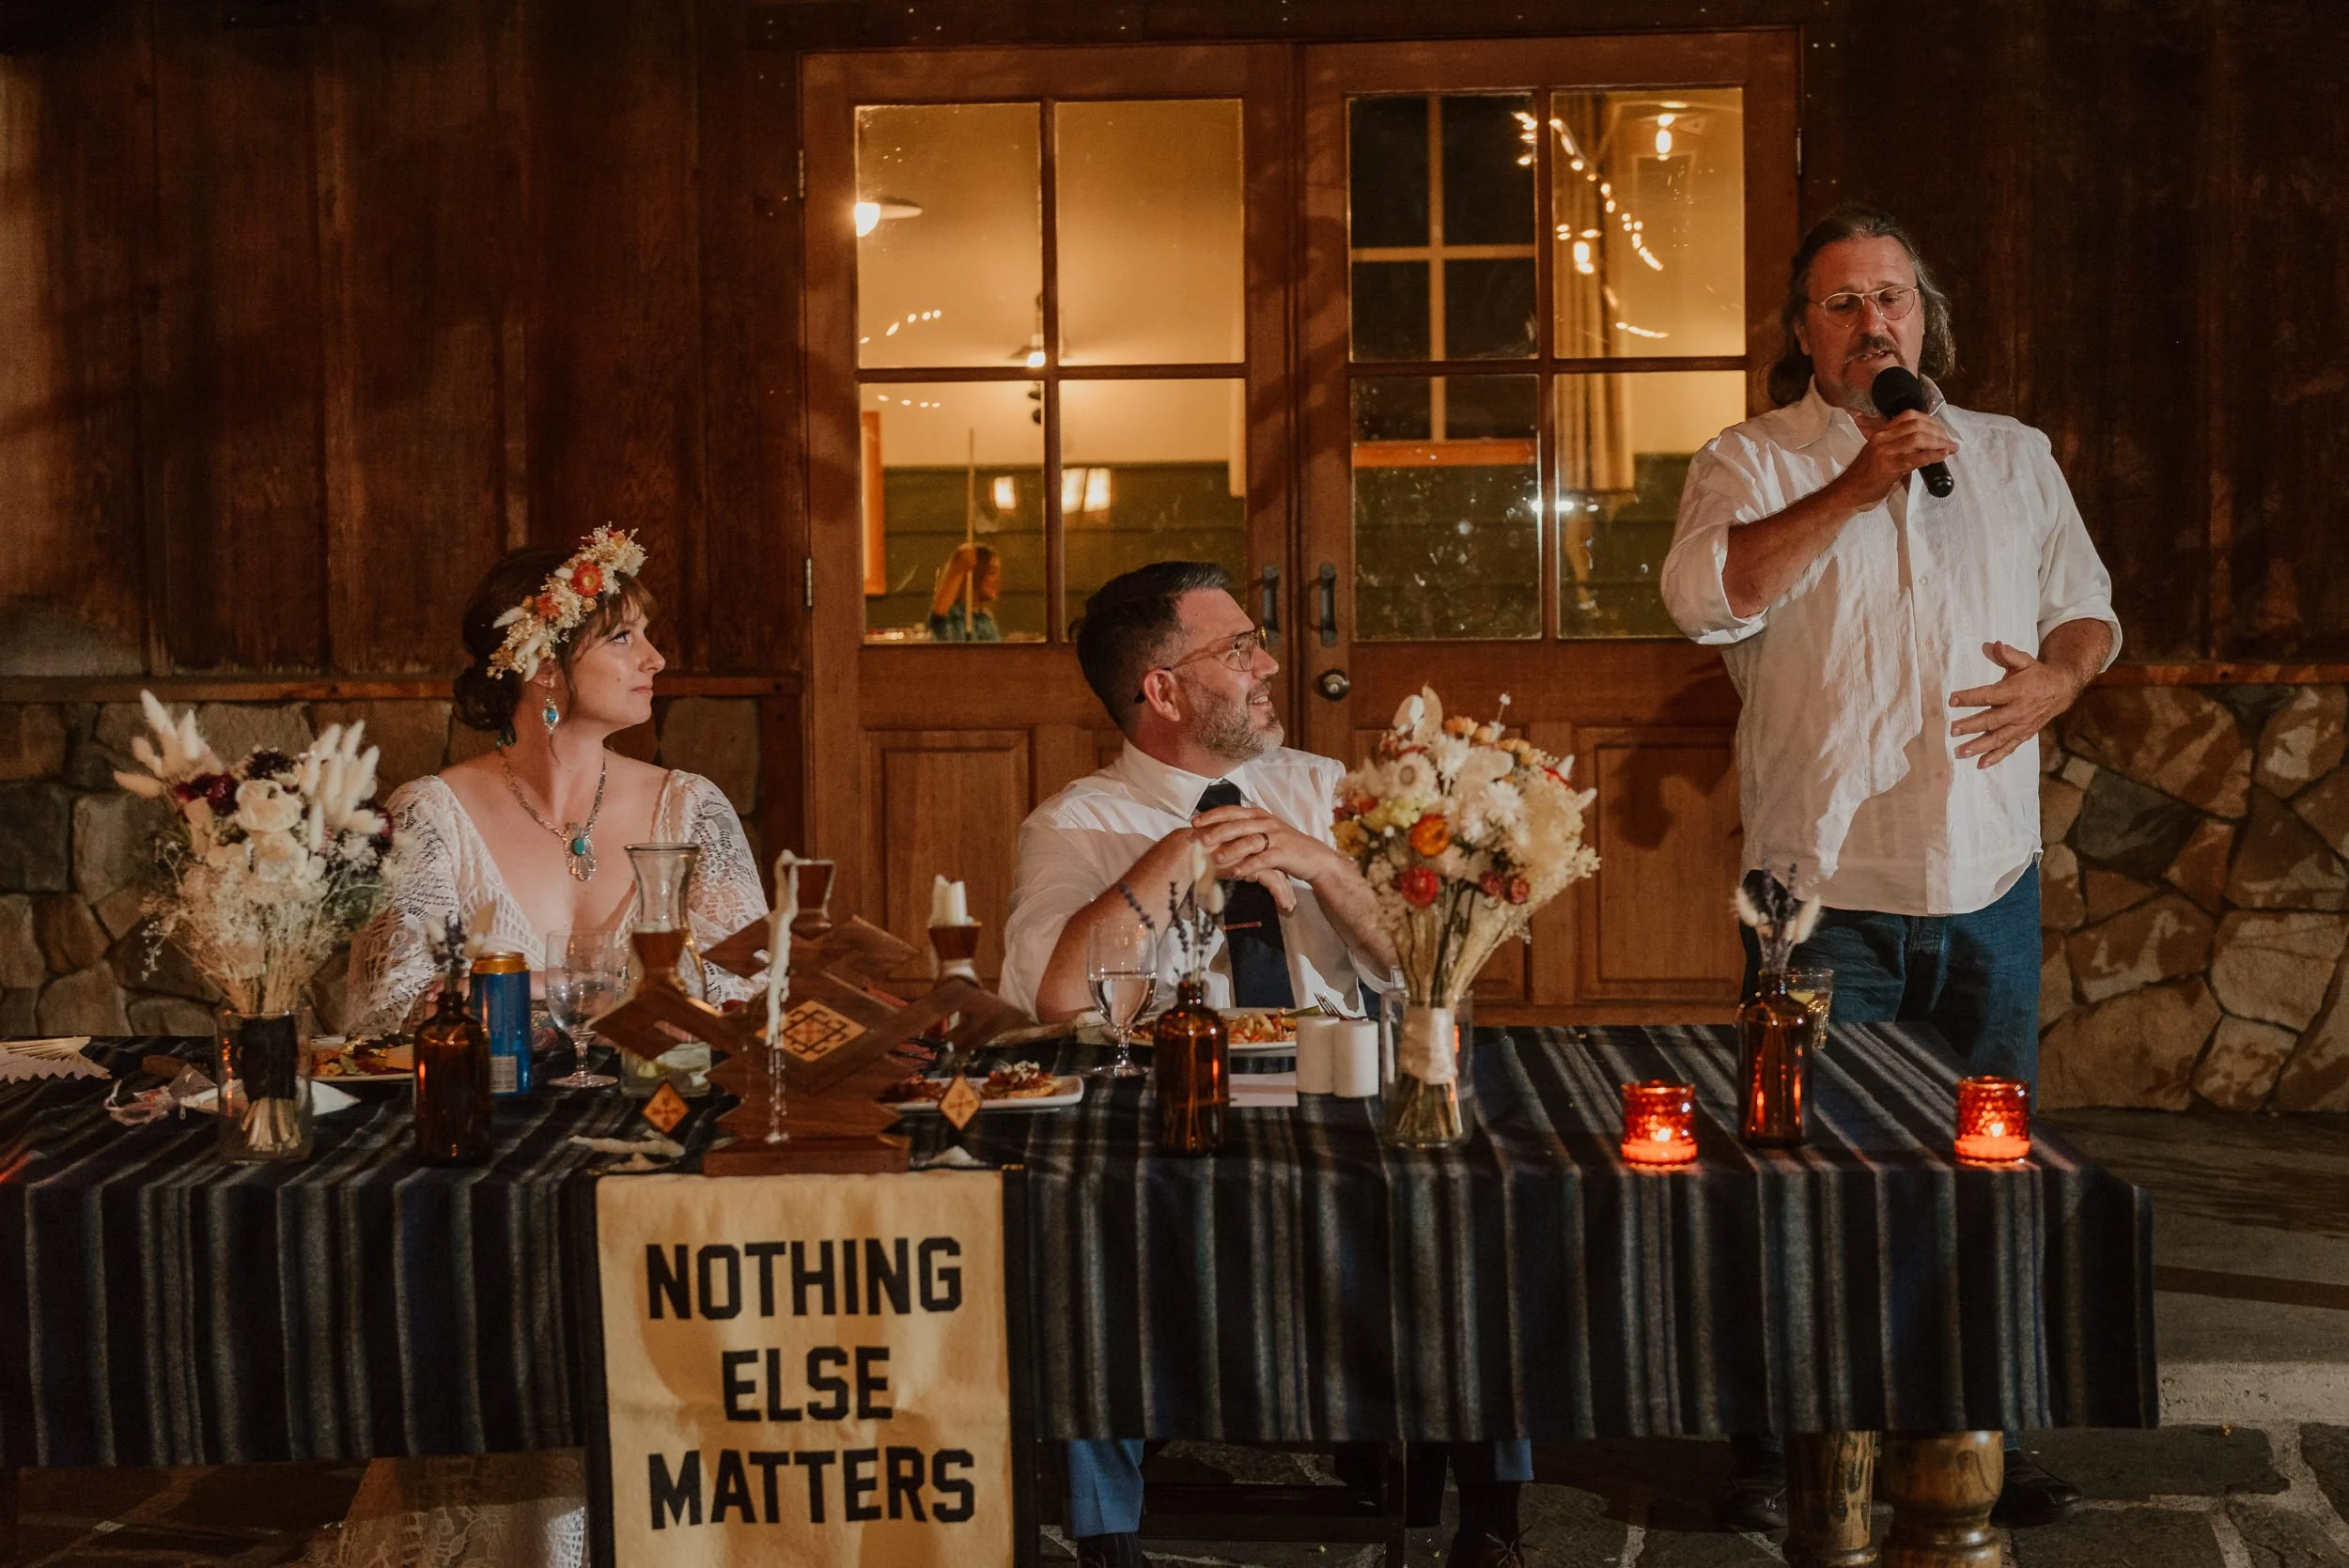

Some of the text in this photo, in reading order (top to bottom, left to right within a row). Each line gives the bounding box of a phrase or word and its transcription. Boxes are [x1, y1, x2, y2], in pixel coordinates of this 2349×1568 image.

[646, 1236, 962, 1321] NOTHING
[722, 1346, 894, 1422] ELSE
[648, 1446, 975, 1531] MATTERS
